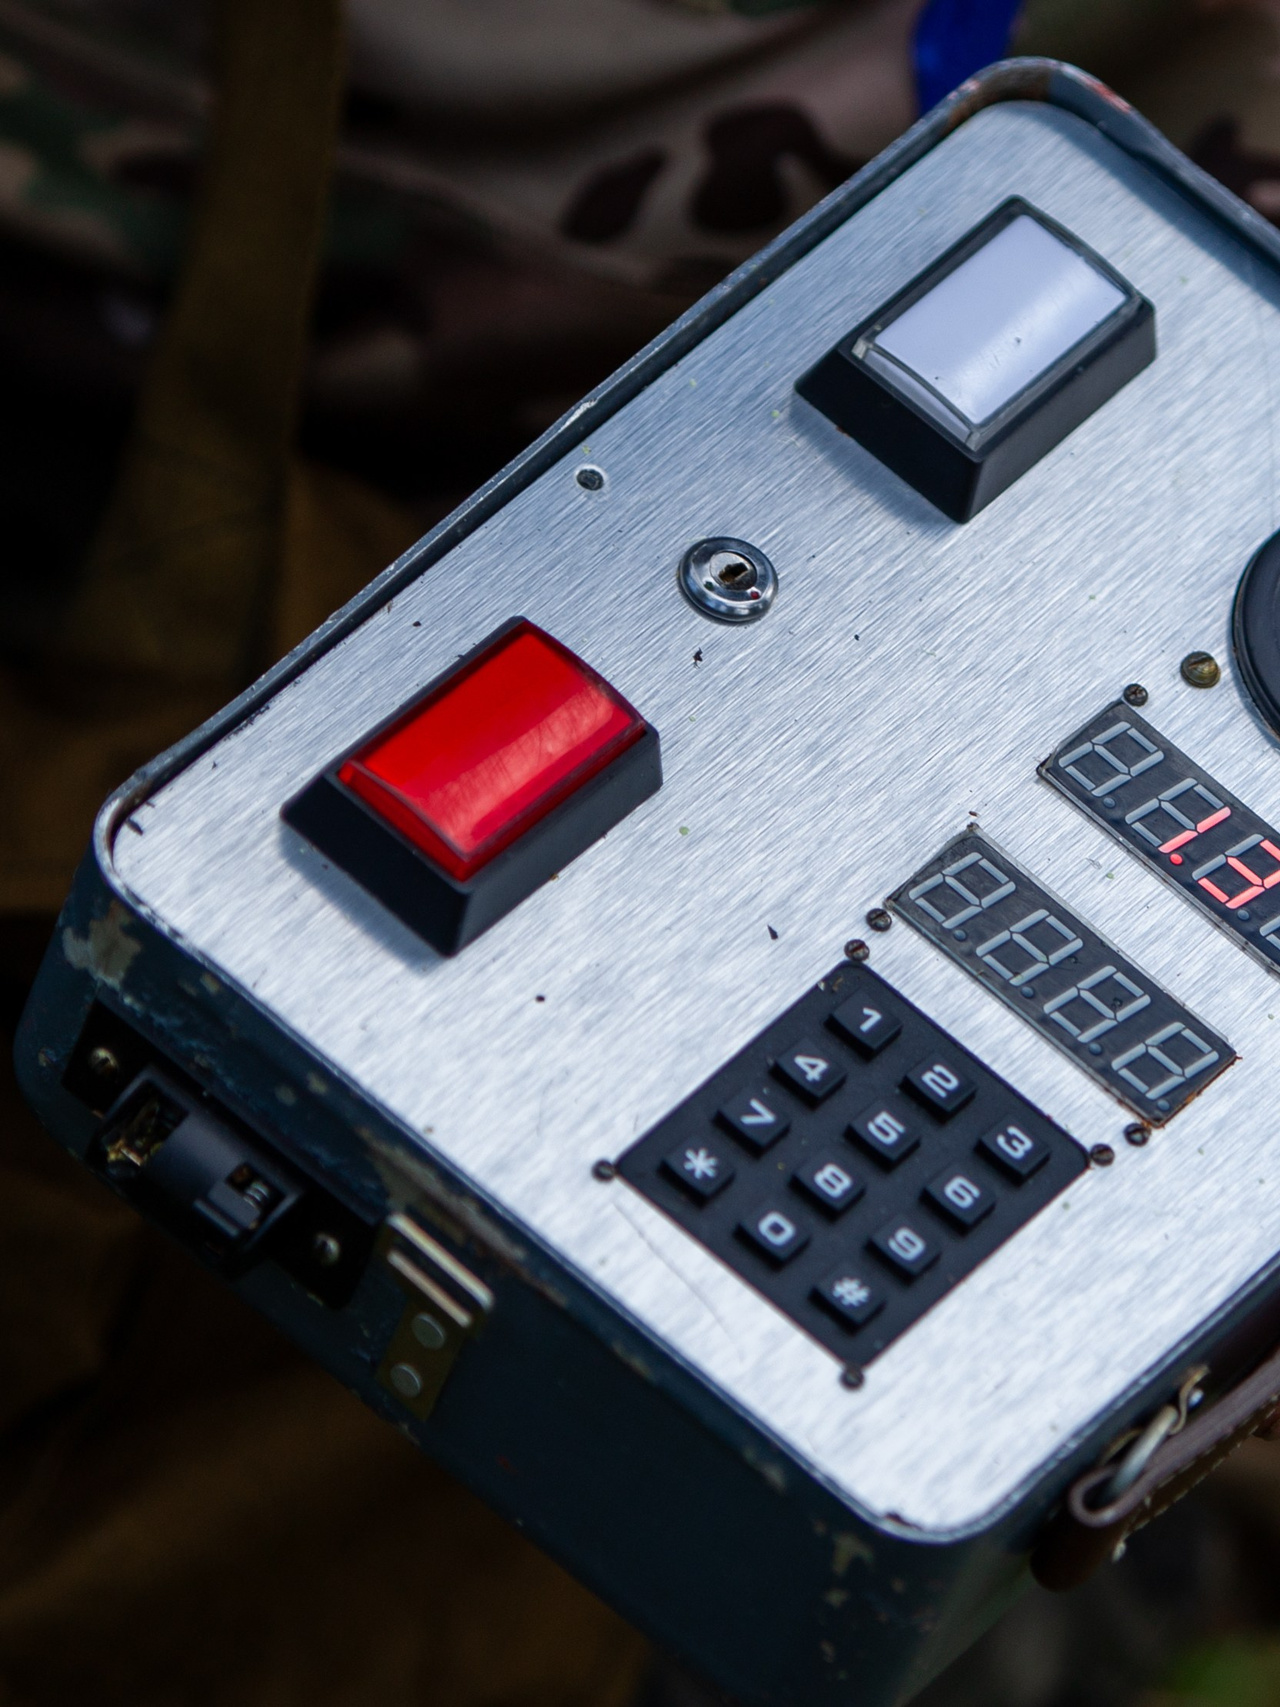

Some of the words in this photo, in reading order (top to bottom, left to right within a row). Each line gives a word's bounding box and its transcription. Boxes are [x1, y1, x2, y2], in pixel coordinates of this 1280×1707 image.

[794, 1055, 828, 1081] 4
[867, 1111, 905, 1144] 5
[944, 1176, 980, 1208] 6
[860, 1007, 882, 1032] 1
[921, 1064, 959, 1098] 2
[996, 1126, 1033, 1159] 3
[741, 1098, 775, 1124] 7
[814, 1163, 852, 1197] 8
[888, 1227, 925, 1260] 9
[758, 1212, 795, 1245] 0
[833, 1278, 869, 1306] #
